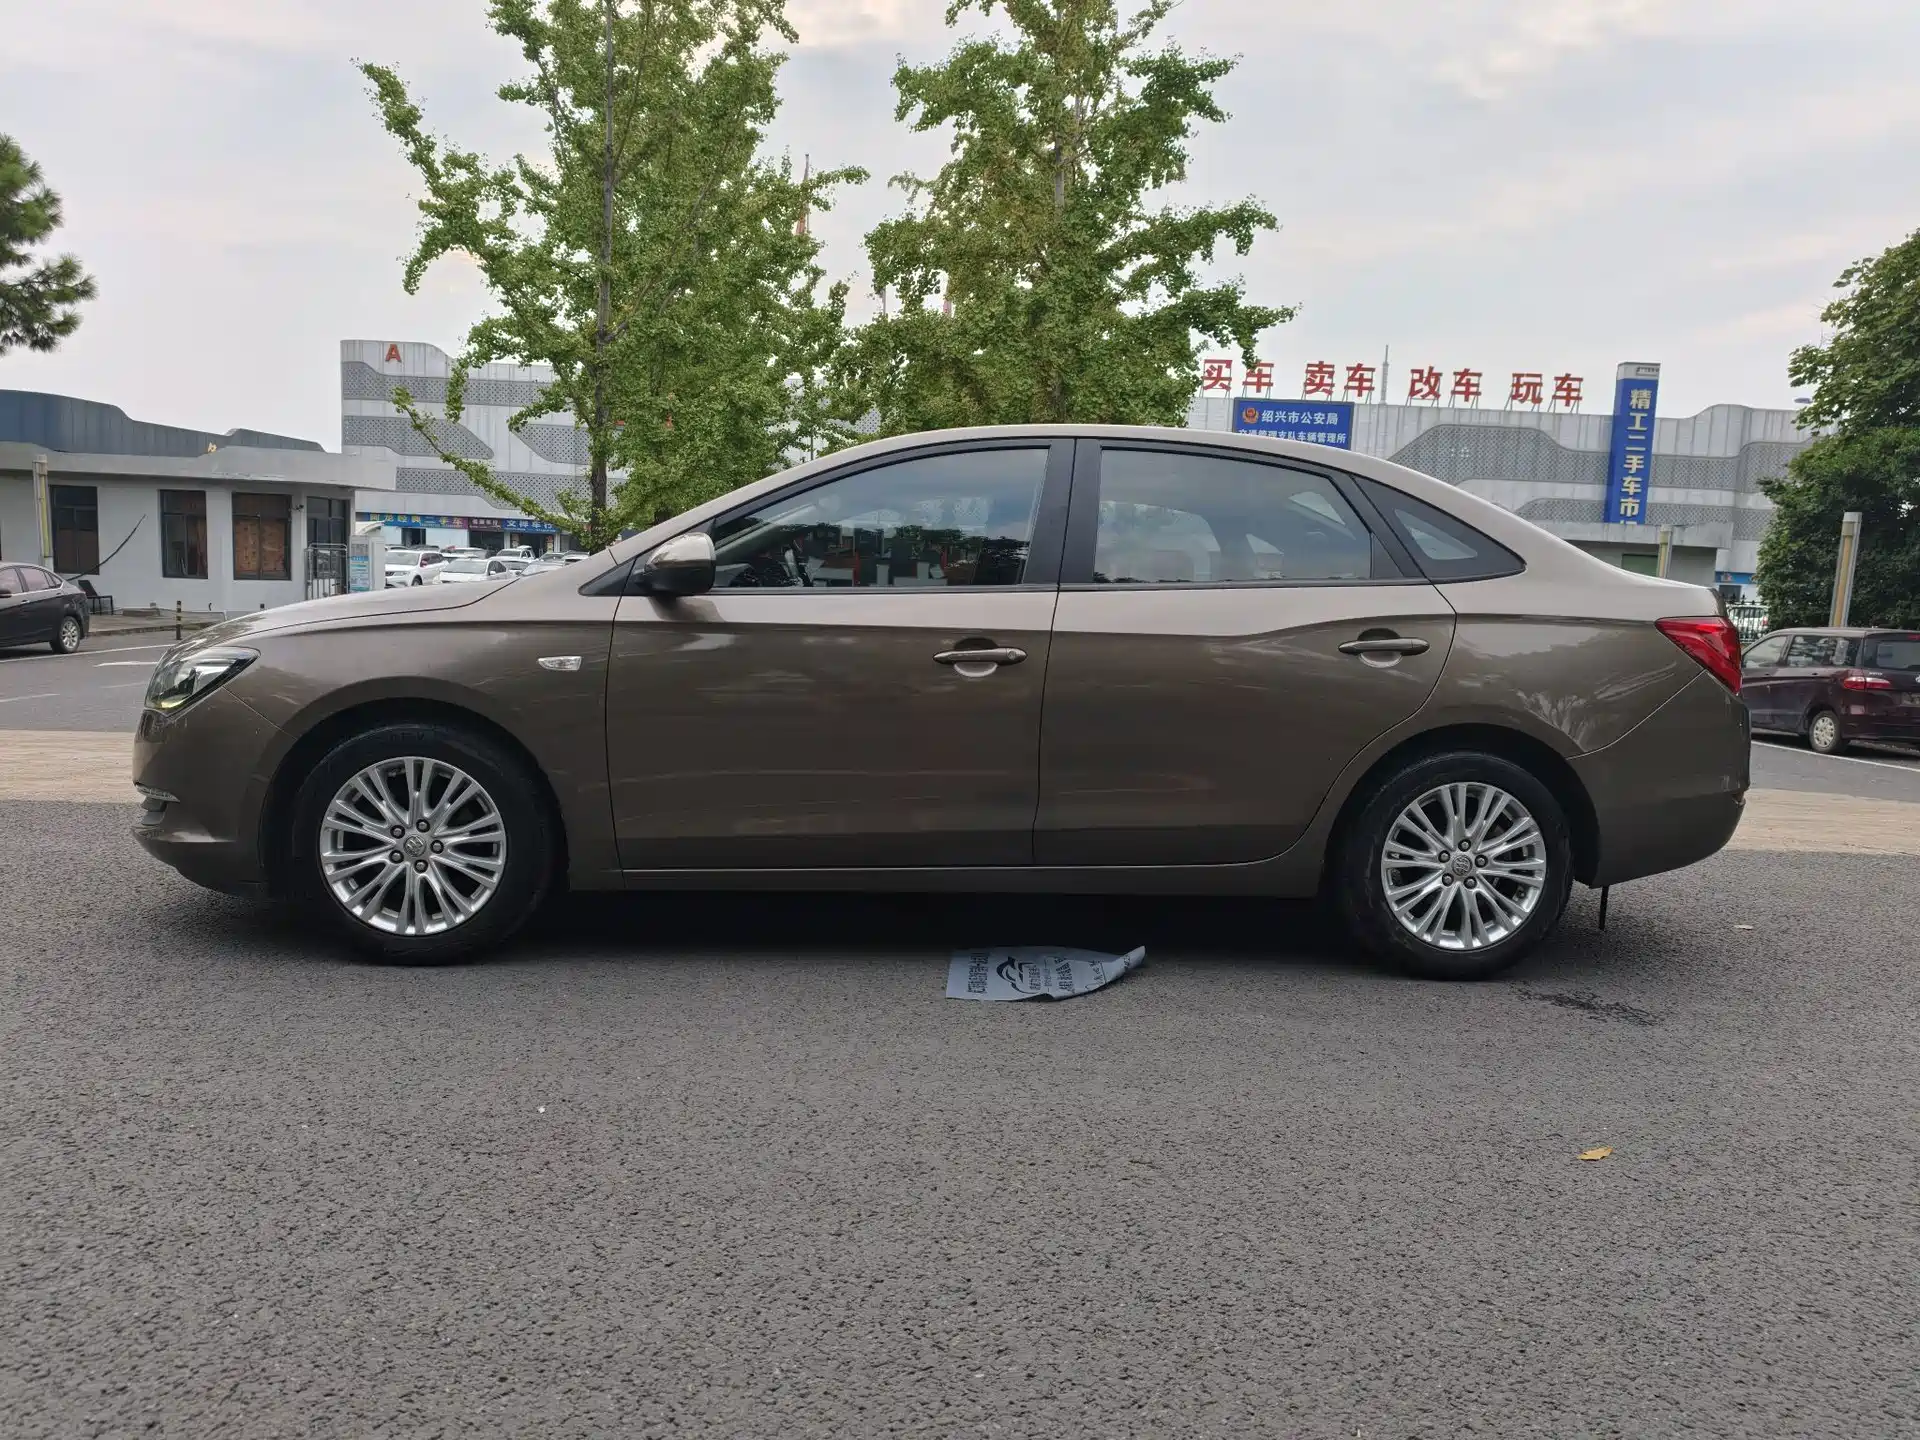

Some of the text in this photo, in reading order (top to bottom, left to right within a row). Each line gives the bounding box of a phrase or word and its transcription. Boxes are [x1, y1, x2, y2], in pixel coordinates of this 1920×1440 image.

[385, 343, 402, 363] A
[1201, 359, 1584, 407] 买车 卖车 改车 玩车
[1261, 409, 1339, 426] 绍兴市公安局
[1619, 388, 1652, 525] 精工二手车市
